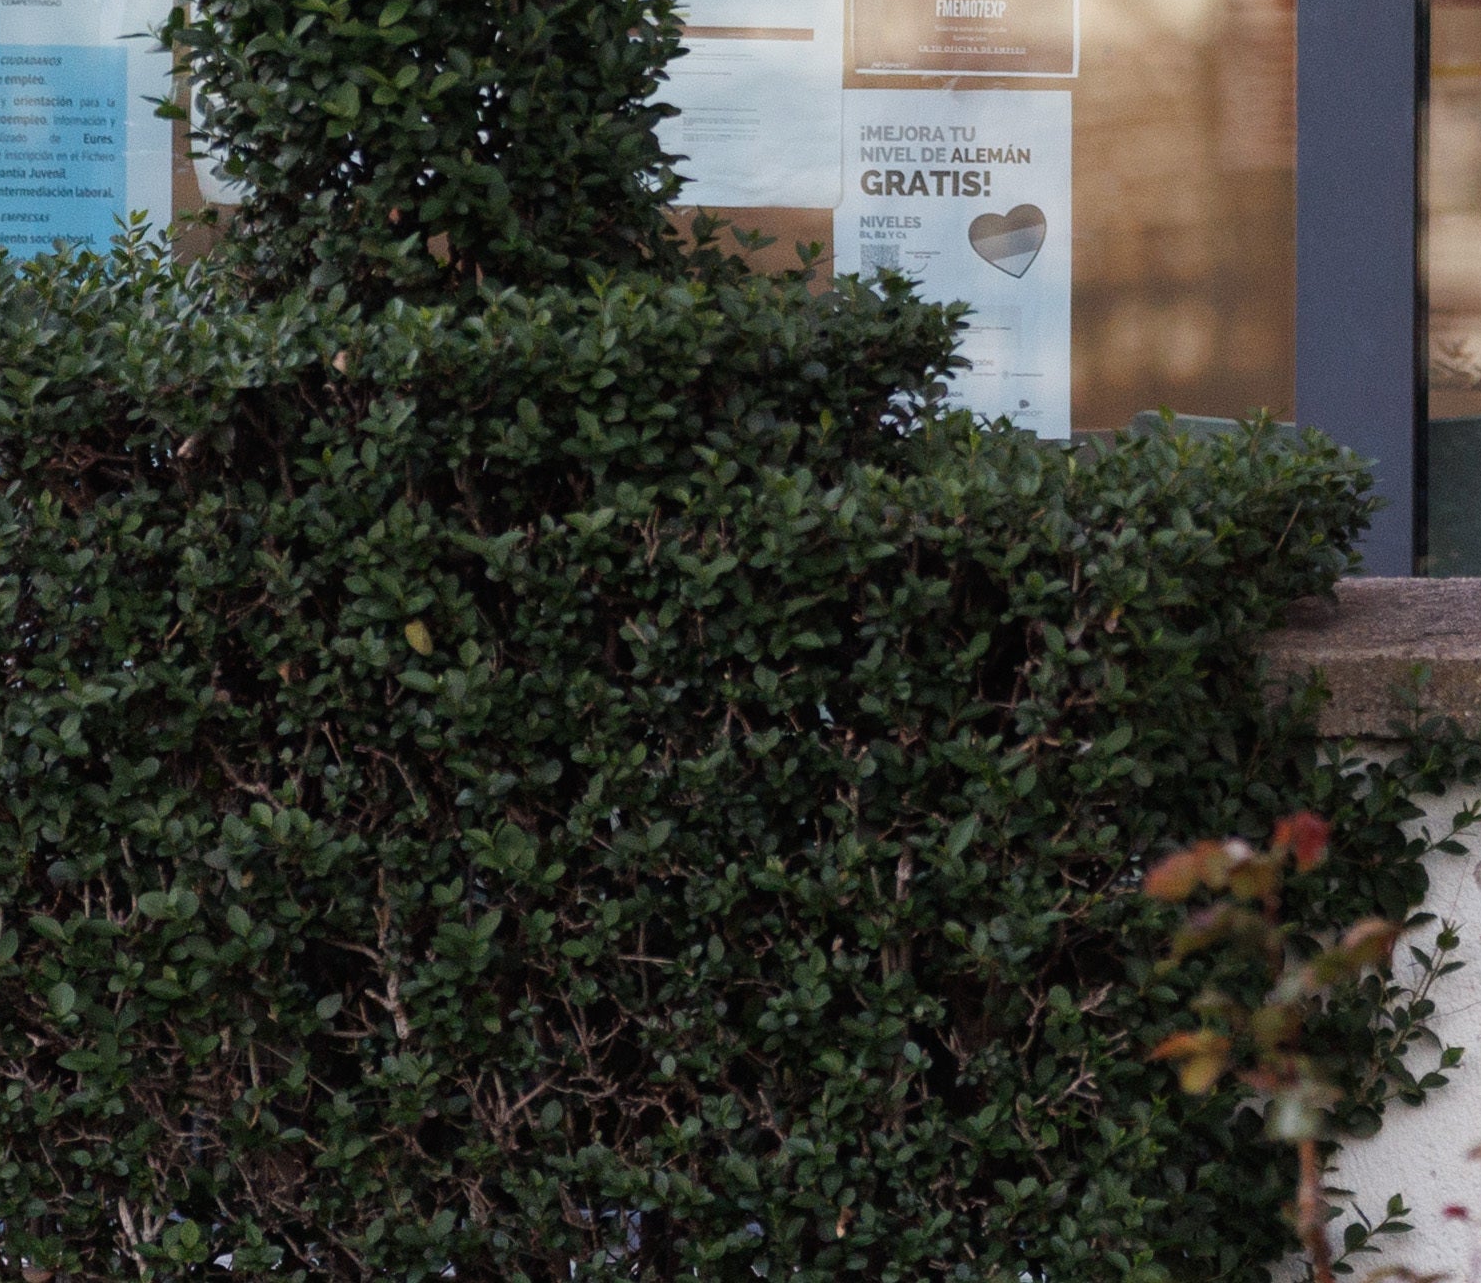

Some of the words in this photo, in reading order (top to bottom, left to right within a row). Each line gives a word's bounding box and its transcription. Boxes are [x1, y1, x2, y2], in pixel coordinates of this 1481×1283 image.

[861, 125, 944, 142] ¡MEJORA
[950, 126, 975, 141] TU
[860, 147, 917, 162] NIVEL
[922, 148, 946, 162] DE
[951, 144, 1031, 163] ALEMÁN
[860, 170, 992, 197] GRATIS!
[860, 216, 921, 229] NIVELES
